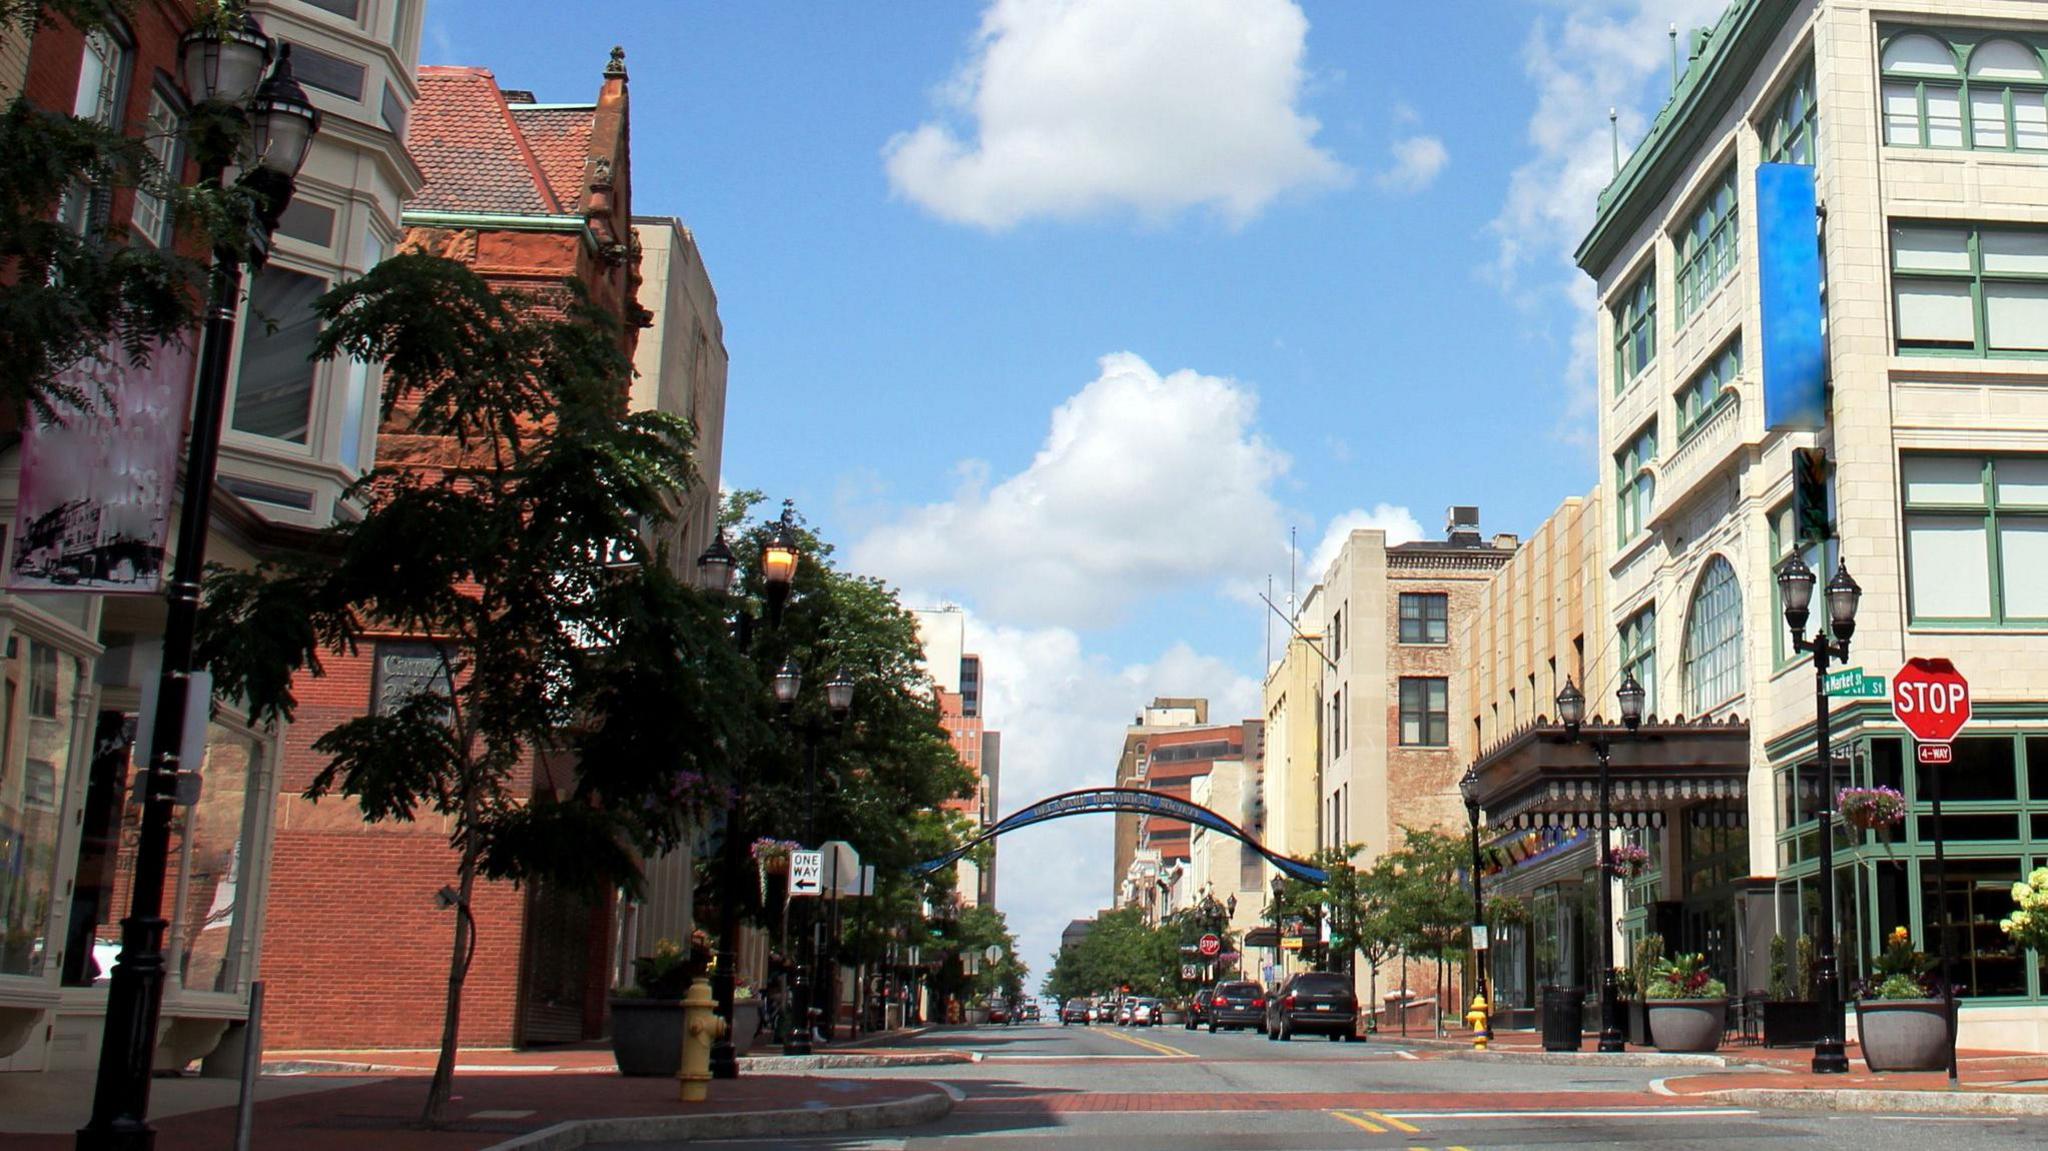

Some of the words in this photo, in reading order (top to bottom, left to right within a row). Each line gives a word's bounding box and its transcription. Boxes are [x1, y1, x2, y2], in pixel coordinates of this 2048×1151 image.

[1830, 672, 1854, 691] Market
[1855, 673, 1862, 685] St
[1872, 682, 1882, 694] St
[1898, 682, 1965, 713] STOP
[1921, 749, 1949, 759] 4-WAY
[1033, 796, 1086, 816] DELAWARE
[1093, 794, 1153, 806] HISTORICAL
[1159, 798, 1200, 818] SOCIETY
[794, 855, 818, 865] ONE
[794, 867, 818, 877] WAY
[1202, 940, 1219, 948] STOP
